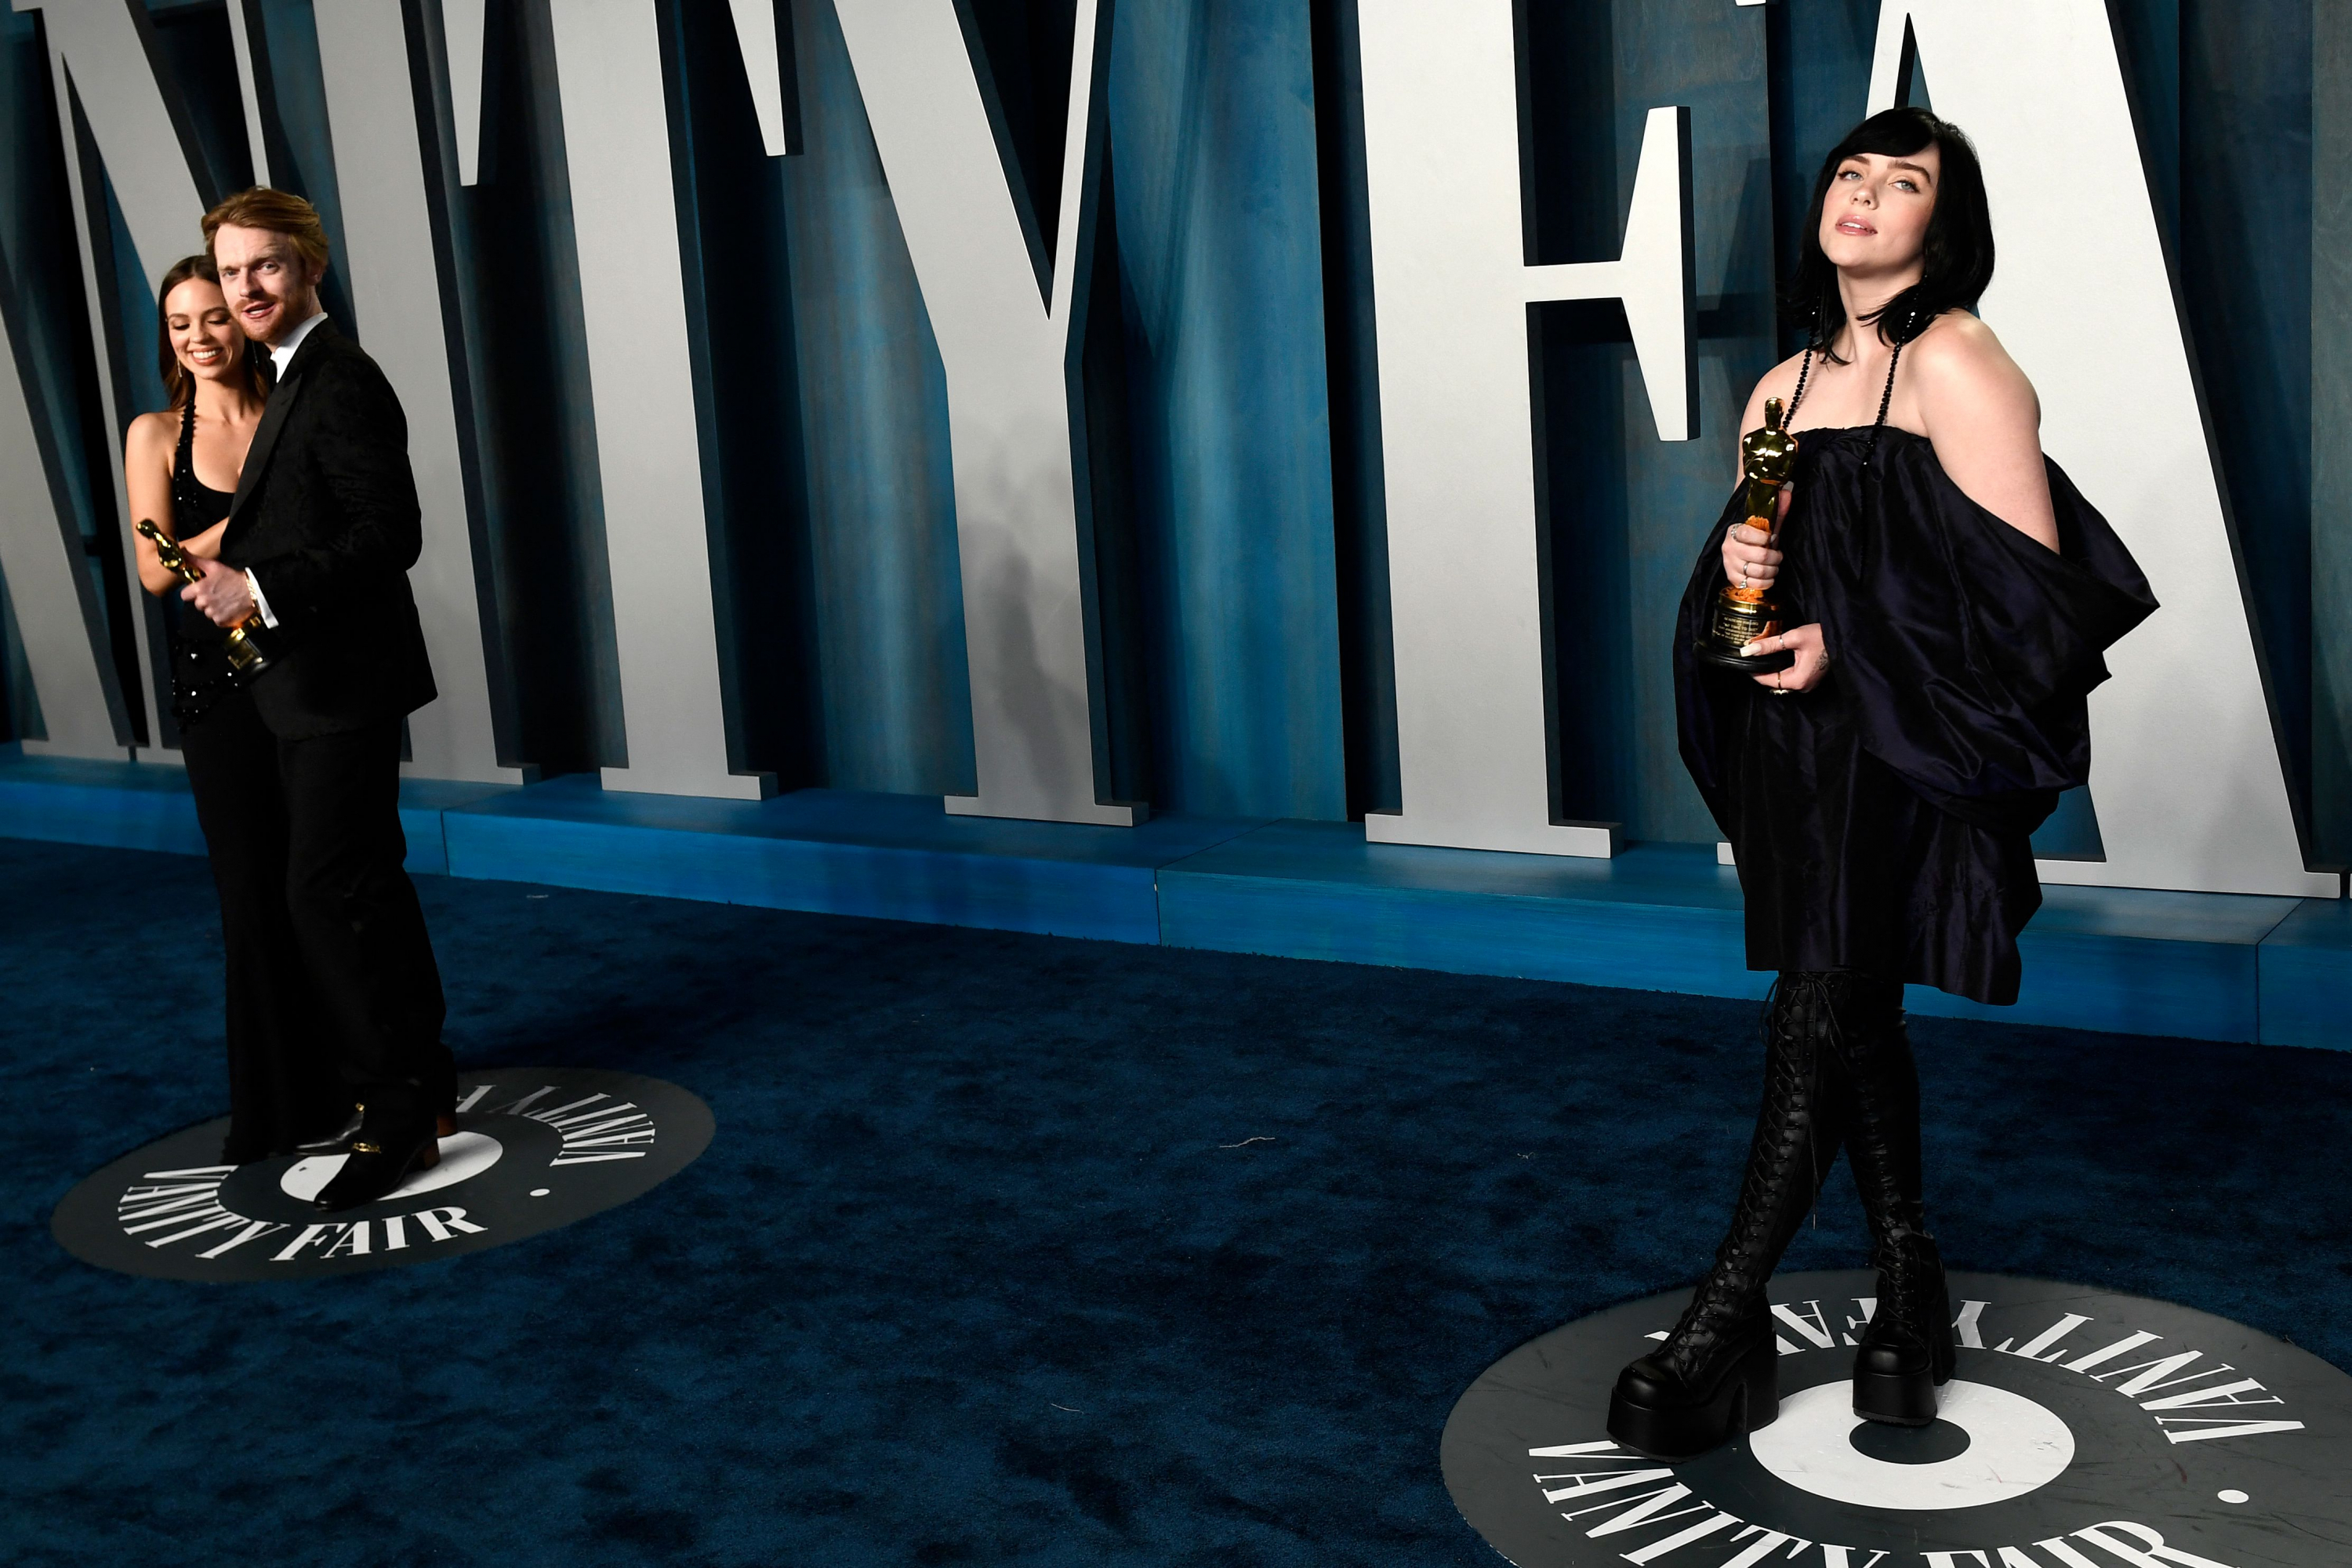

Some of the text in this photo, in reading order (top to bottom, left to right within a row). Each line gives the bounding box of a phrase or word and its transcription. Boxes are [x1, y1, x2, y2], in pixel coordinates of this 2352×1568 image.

[0, 0, 2352, 899] NITY FA
[484, 1084, 655, 1167] VANITY
[118, 1165, 488, 1261] VANITY FAIR
[1528, 1439, 1891, 1568] VANIT
